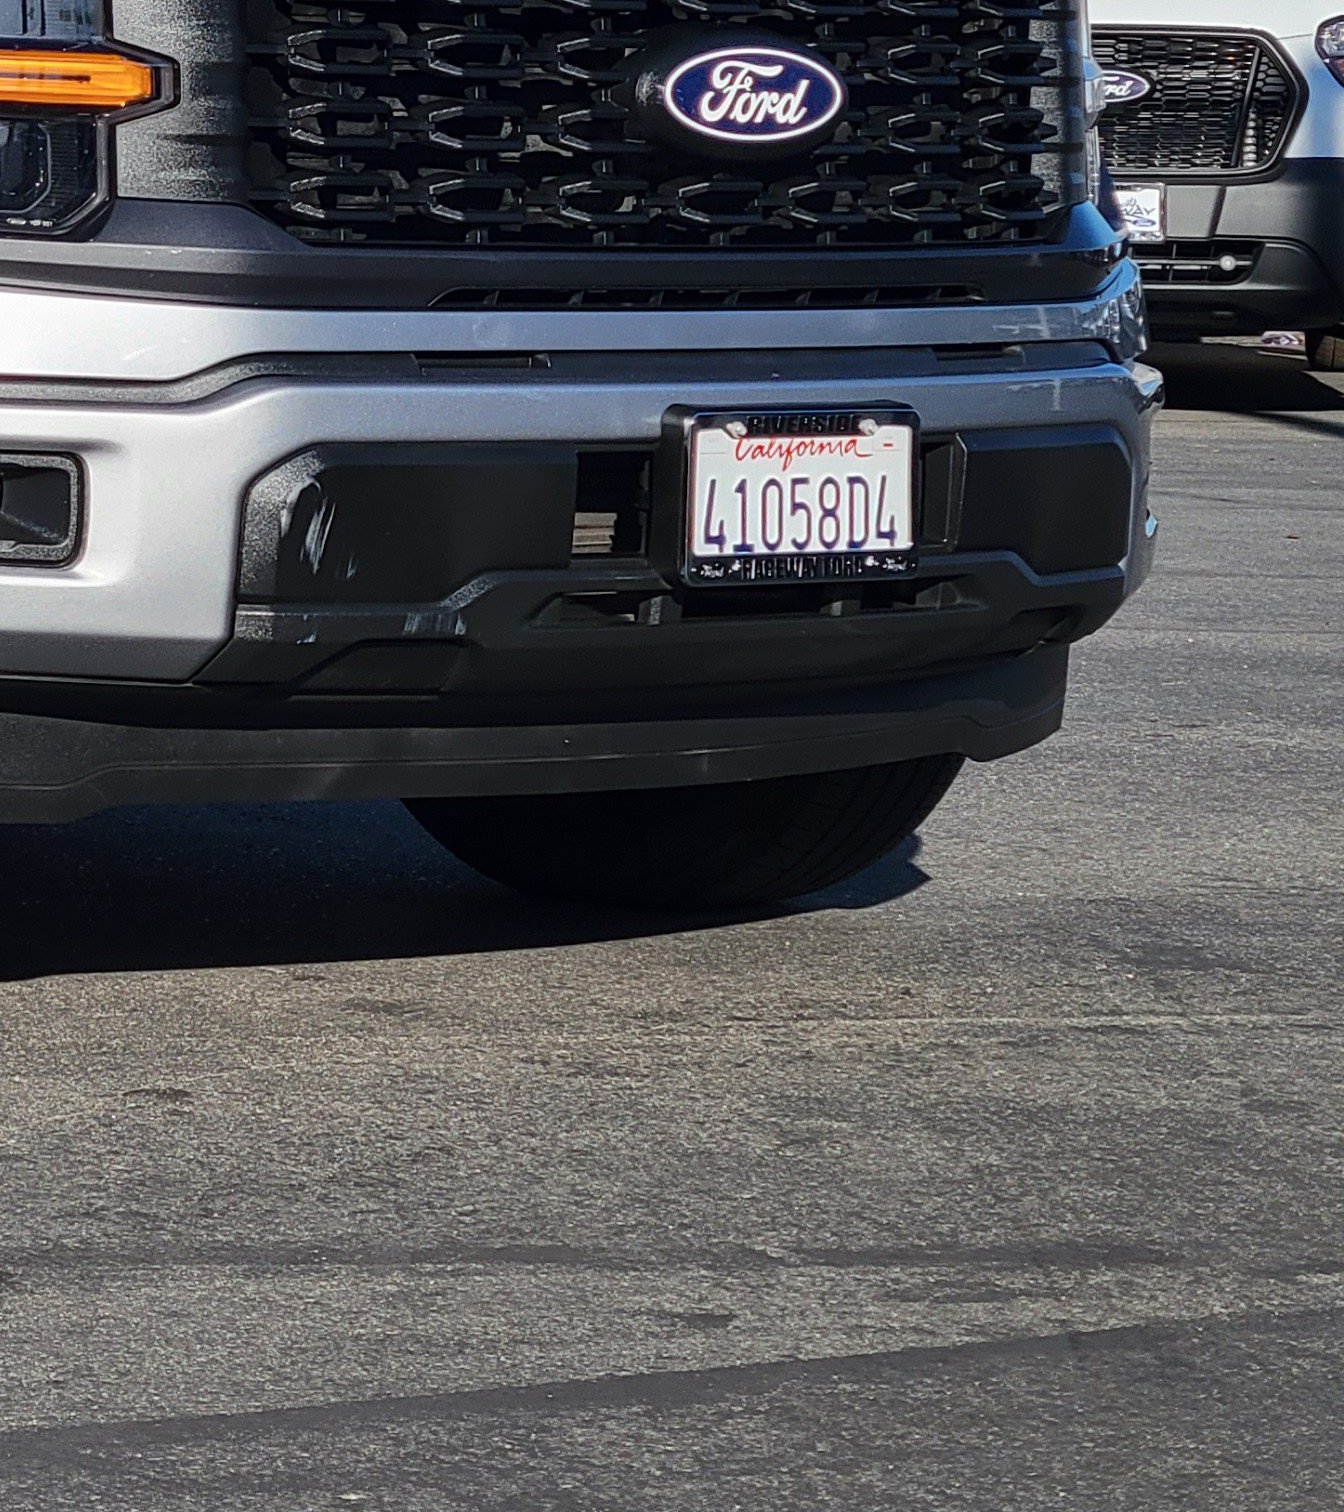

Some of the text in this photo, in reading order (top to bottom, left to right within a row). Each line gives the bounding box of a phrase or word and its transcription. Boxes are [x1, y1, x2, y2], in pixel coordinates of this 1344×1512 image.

[700, 60, 811, 125] Ford
[1101, 75, 1135, 96] rd
[735, 437, 874, 472] California
[703, 474, 898, 553] 41058D4
